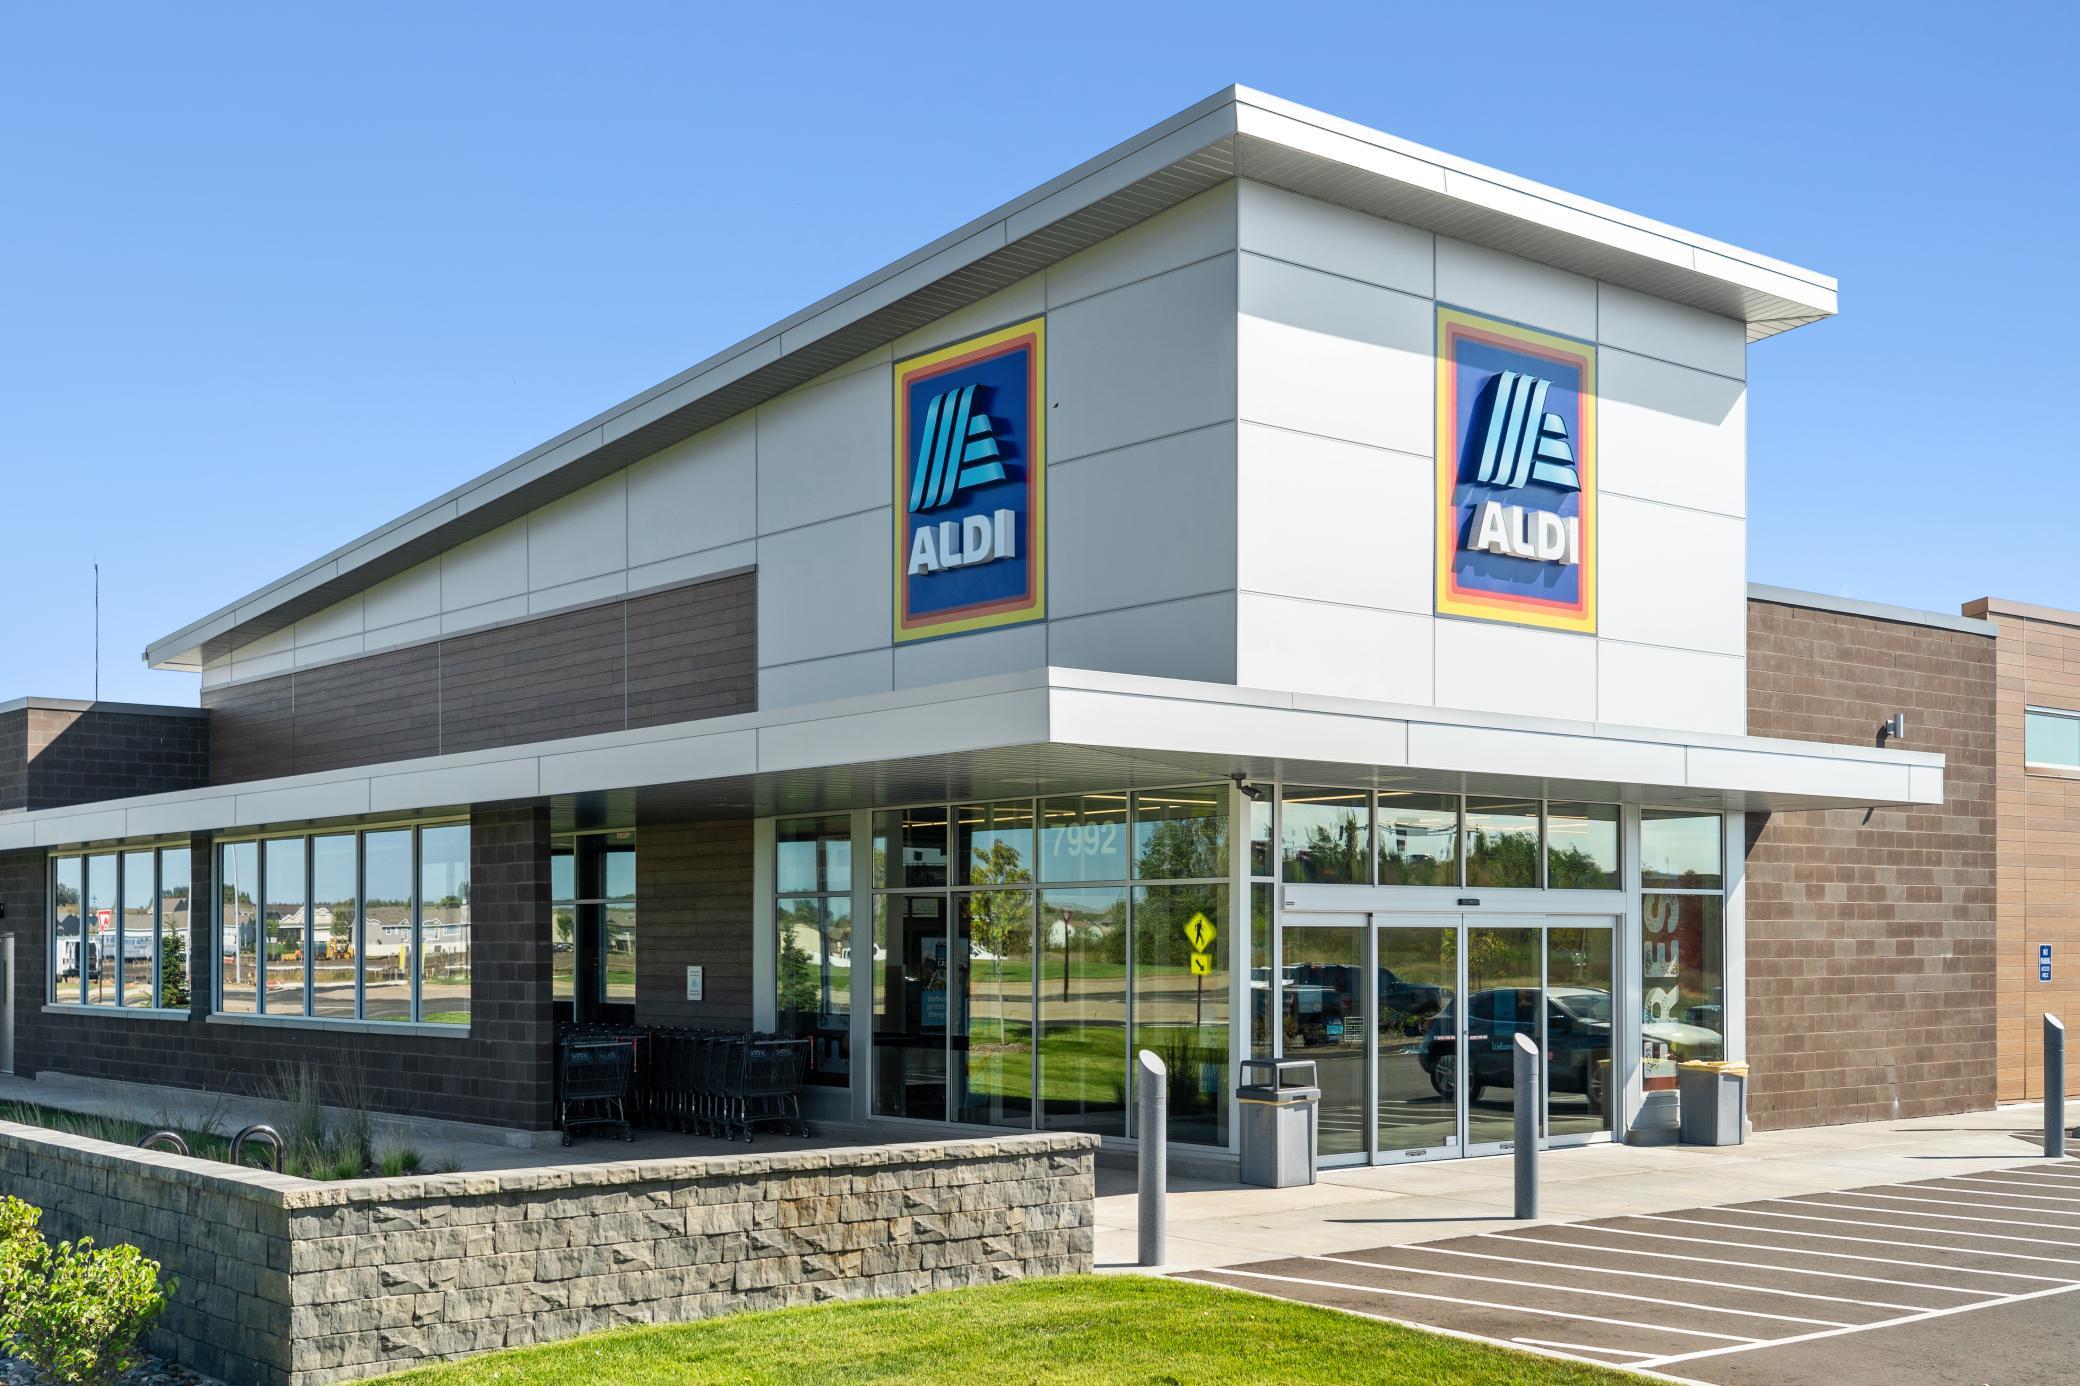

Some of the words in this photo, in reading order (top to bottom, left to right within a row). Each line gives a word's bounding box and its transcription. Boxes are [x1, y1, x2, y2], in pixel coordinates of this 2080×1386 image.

[907, 508, 1016, 576] ALDI
[1468, 500, 1580, 566] ALDI
[1050, 820, 1117, 856] 7992
